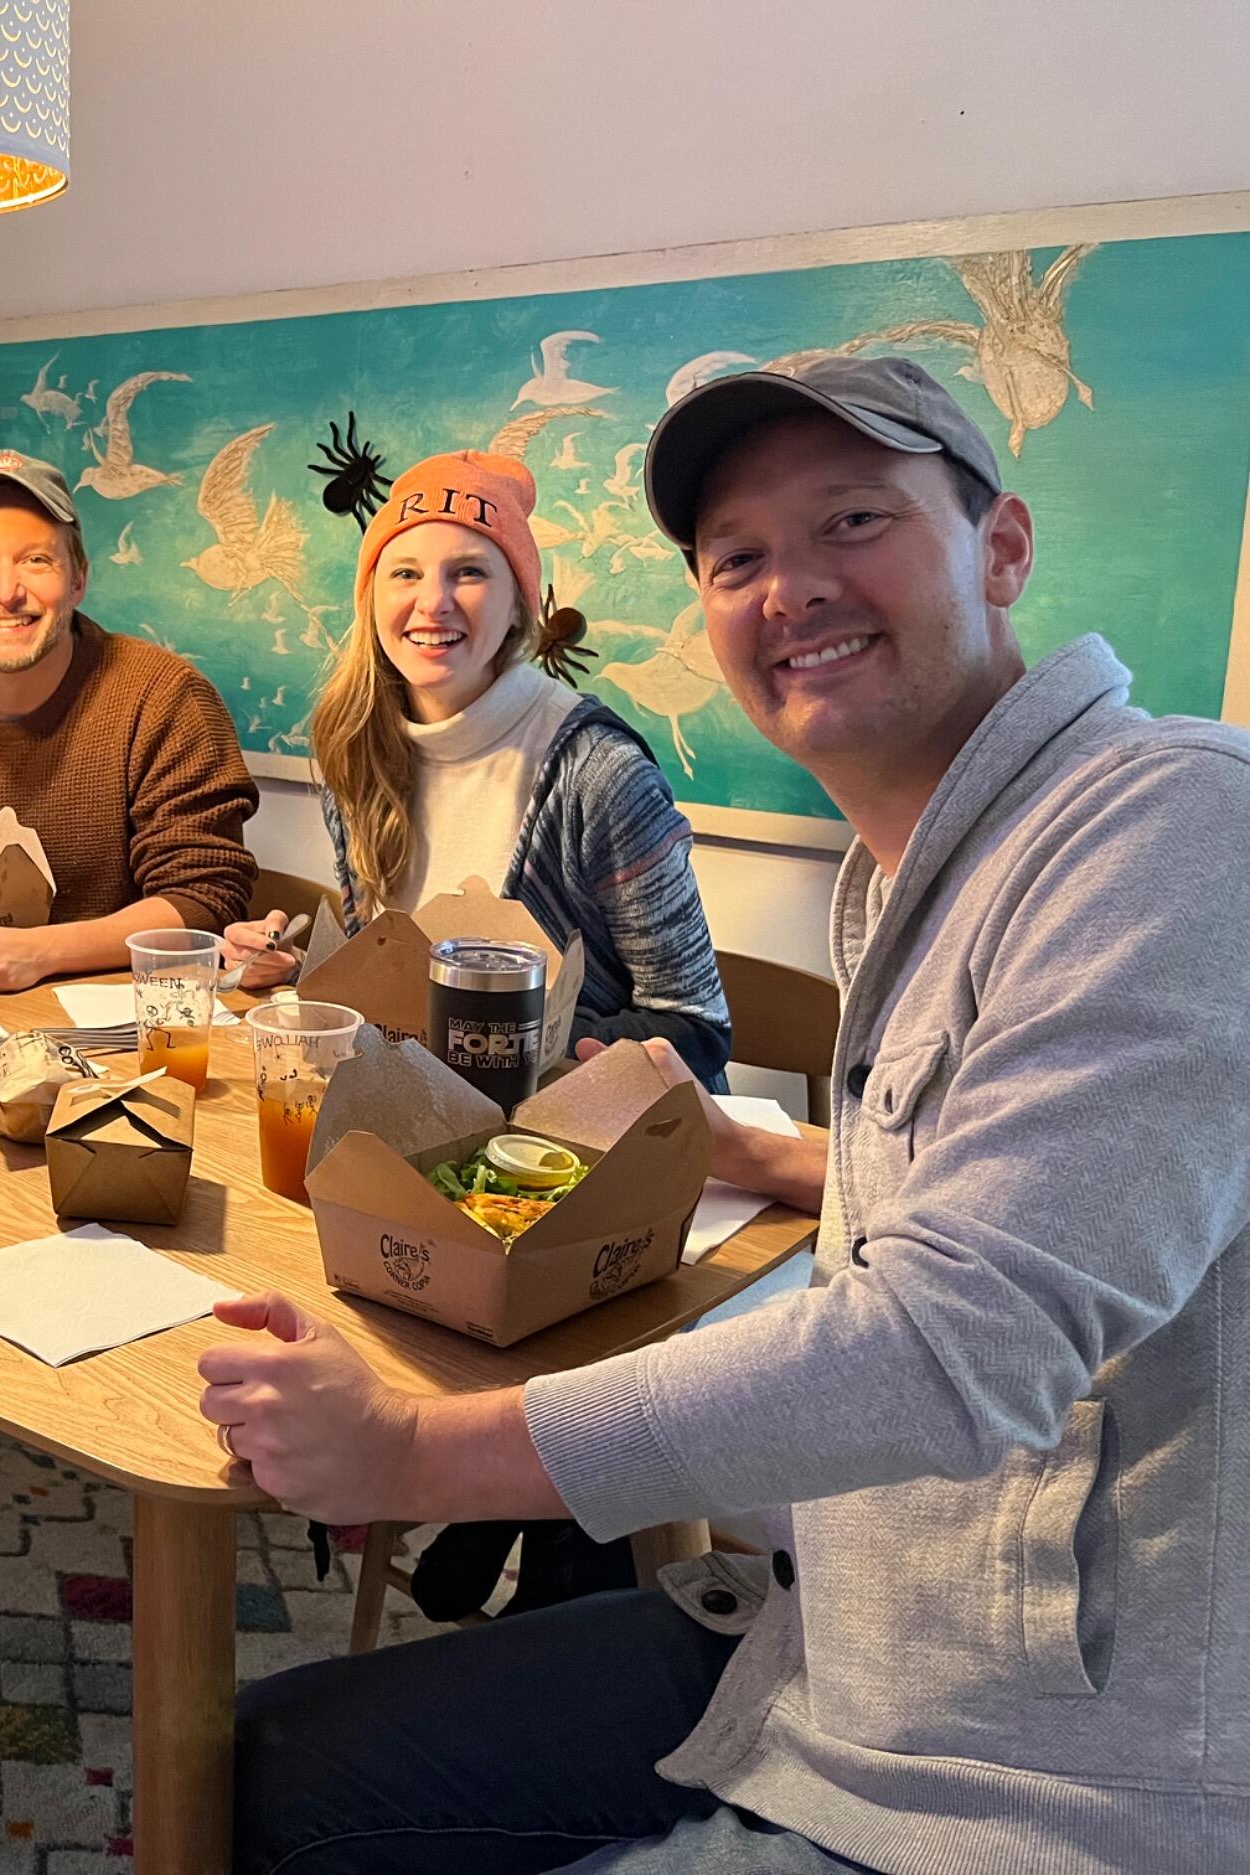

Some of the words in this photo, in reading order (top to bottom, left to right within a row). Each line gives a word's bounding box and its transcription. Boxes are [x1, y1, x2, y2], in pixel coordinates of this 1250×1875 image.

[397, 488, 498, 528] RIT
[448, 1017, 485, 1032] MAY
[488, 1022, 517, 1033] THE
[447, 1049, 472, 1067] BE
[476, 1053, 519, 1068] WITH
[380, 1234, 430, 1262] Claire's
[593, 1227, 654, 1278] Claire's
